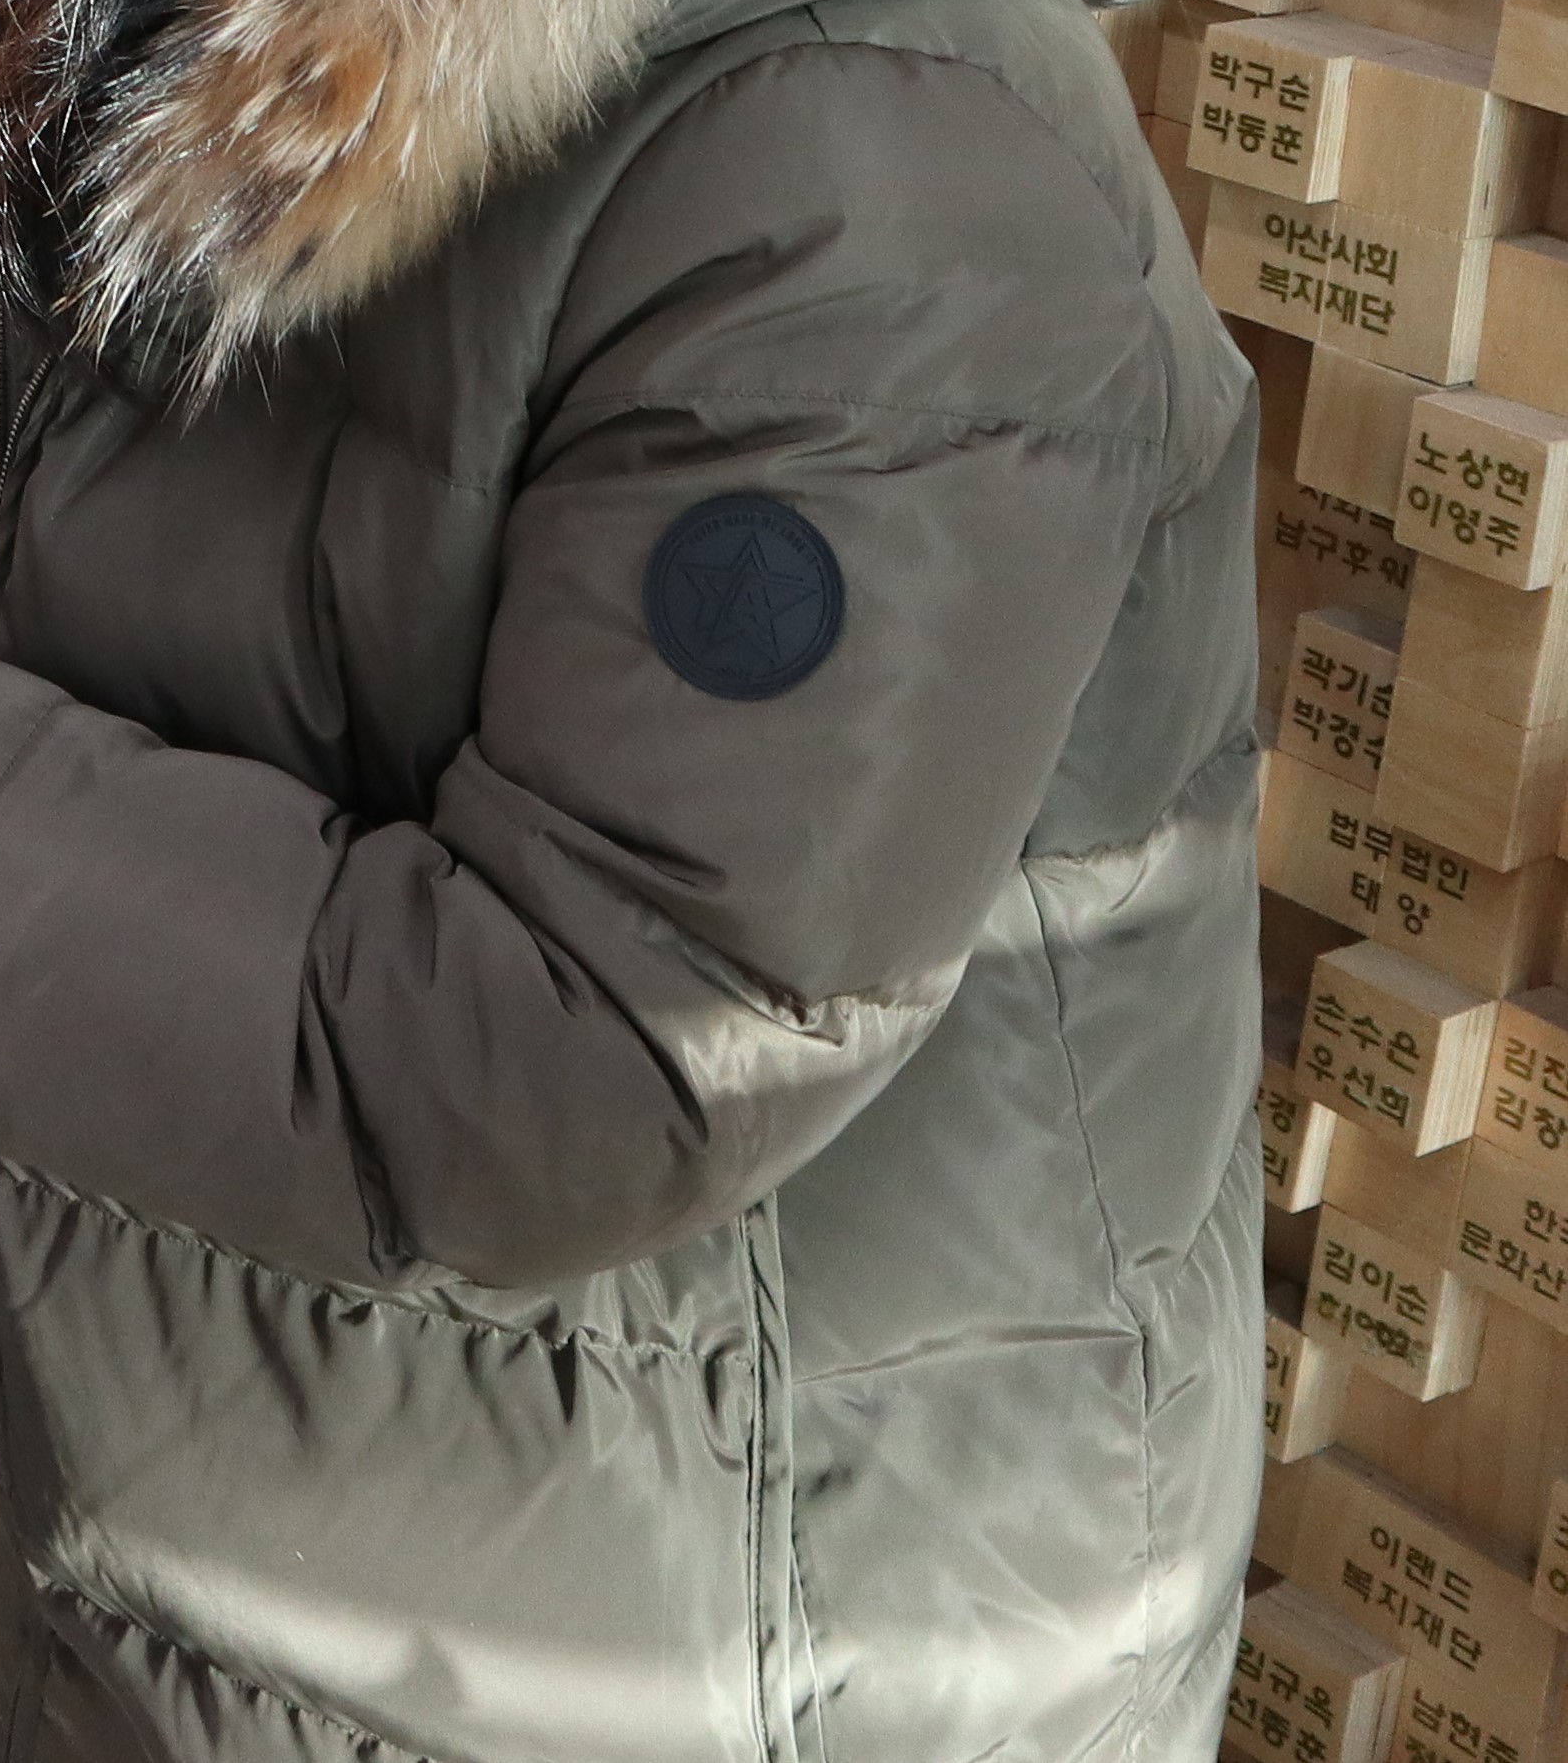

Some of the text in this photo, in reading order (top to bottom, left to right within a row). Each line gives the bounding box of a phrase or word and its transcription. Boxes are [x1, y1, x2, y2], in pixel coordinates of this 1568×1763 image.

[1209, 52, 1310, 113] 박구순
[1265, 213, 1398, 285] 아산사회
[1259, 261, 1396, 336] 복지재단
[1415, 432, 1530, 507] 노상현
[1408, 485, 1521, 557] 이영주
[1331, 810, 1469, 900] 법무법인
[1325, 1240, 1428, 1325] 김이순
[1370, 1525, 1472, 1614] 이랜드
[1342, 1558, 1482, 1672] 복지재단
